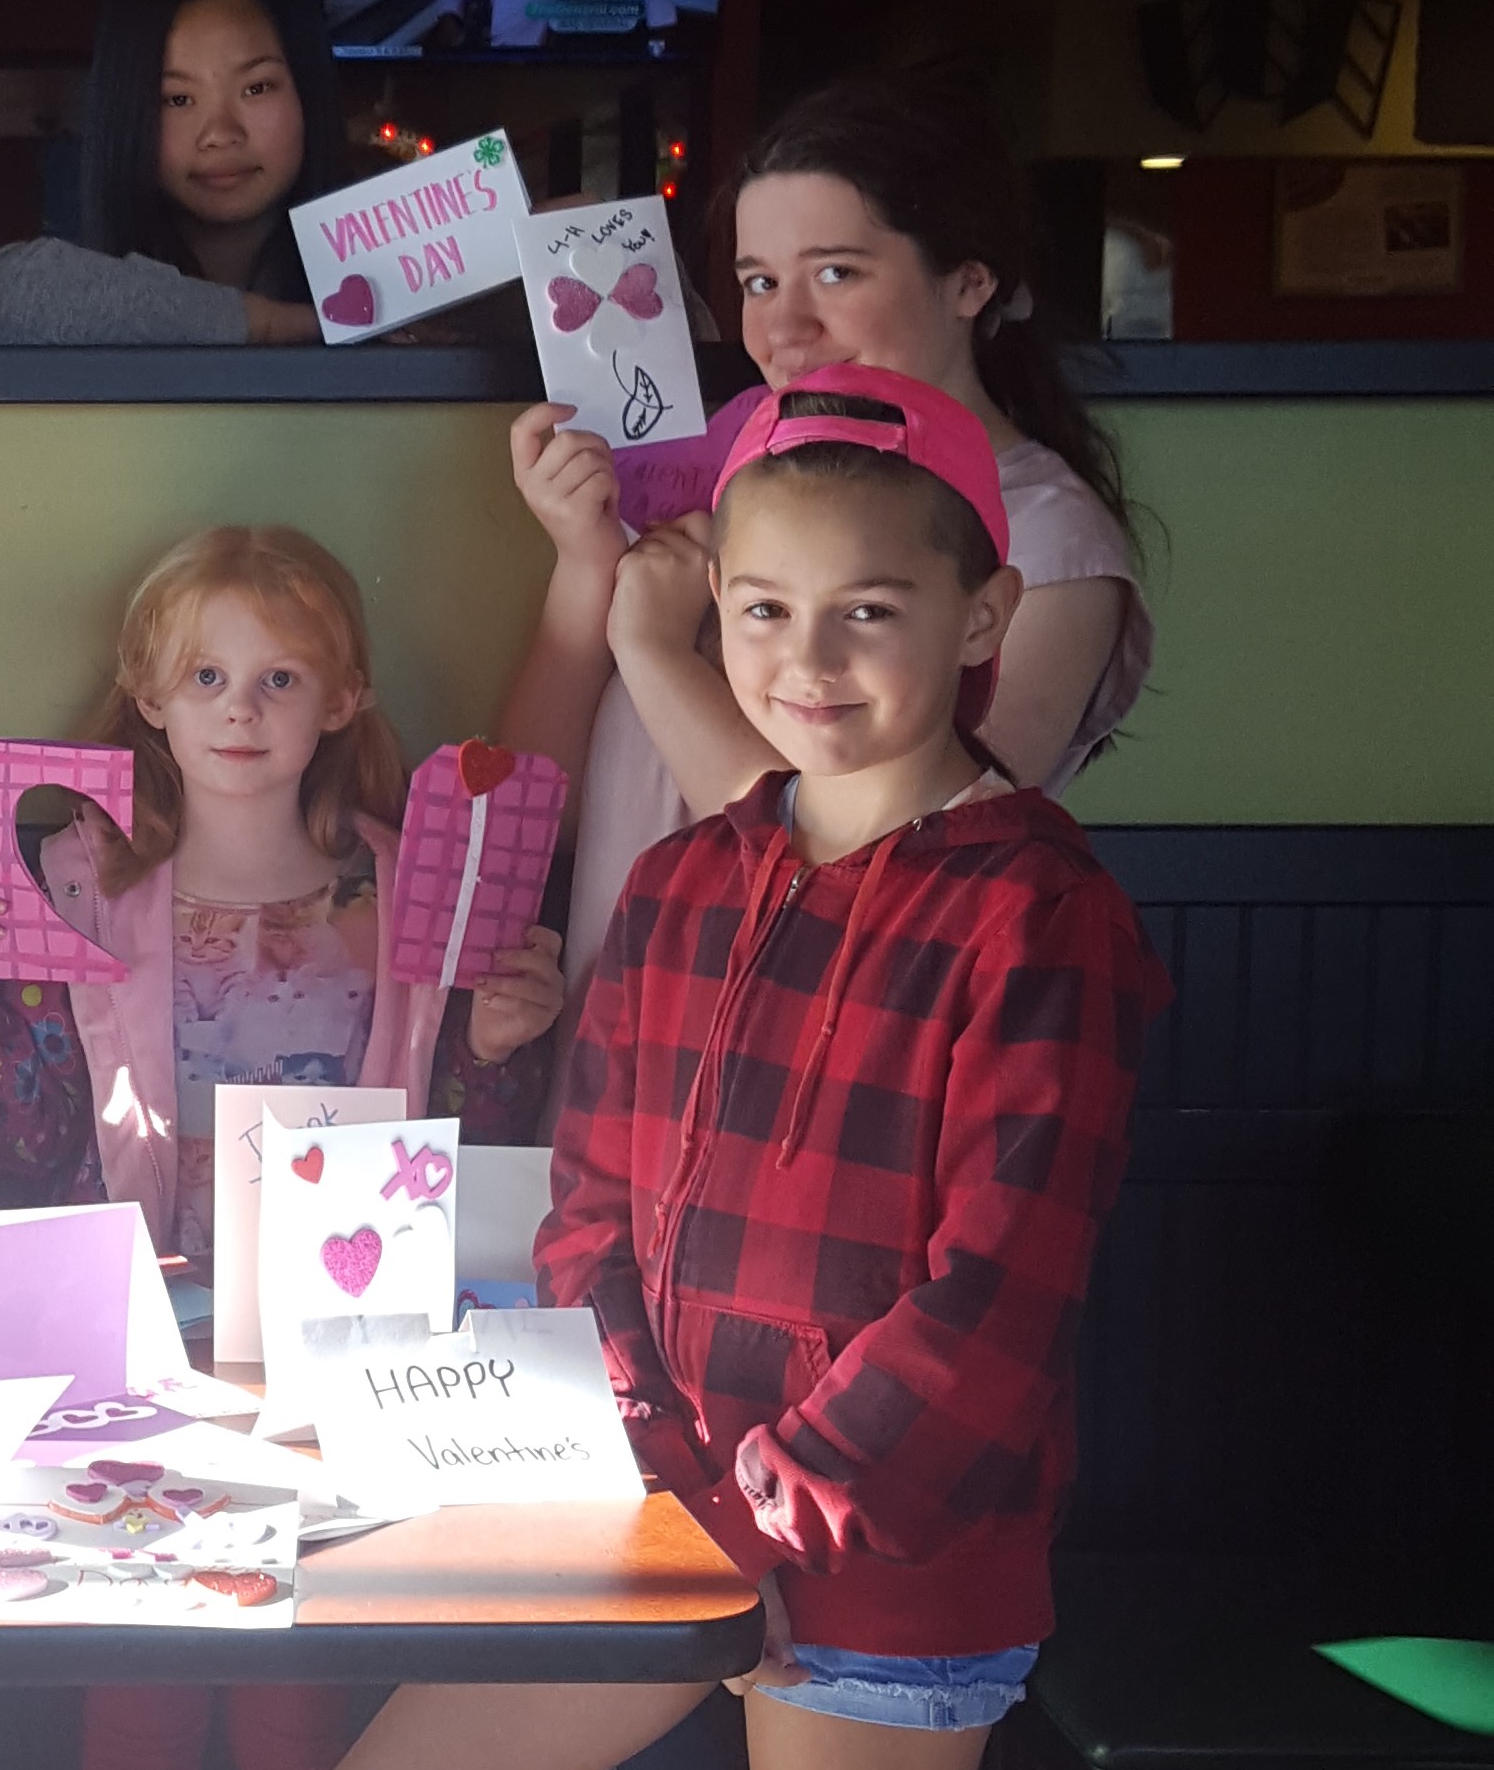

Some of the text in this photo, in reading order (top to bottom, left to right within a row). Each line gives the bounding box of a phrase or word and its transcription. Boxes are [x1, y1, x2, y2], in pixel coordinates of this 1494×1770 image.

[320, 169, 498, 263] VALENTINE'S
[547, 225, 585, 255] 4-H
[591, 208, 633, 244] LOVES
[398, 235, 466, 294] DAY
[364, 1358, 515, 1410] HAPPY
[406, 1433, 592, 1470] Valentine's
